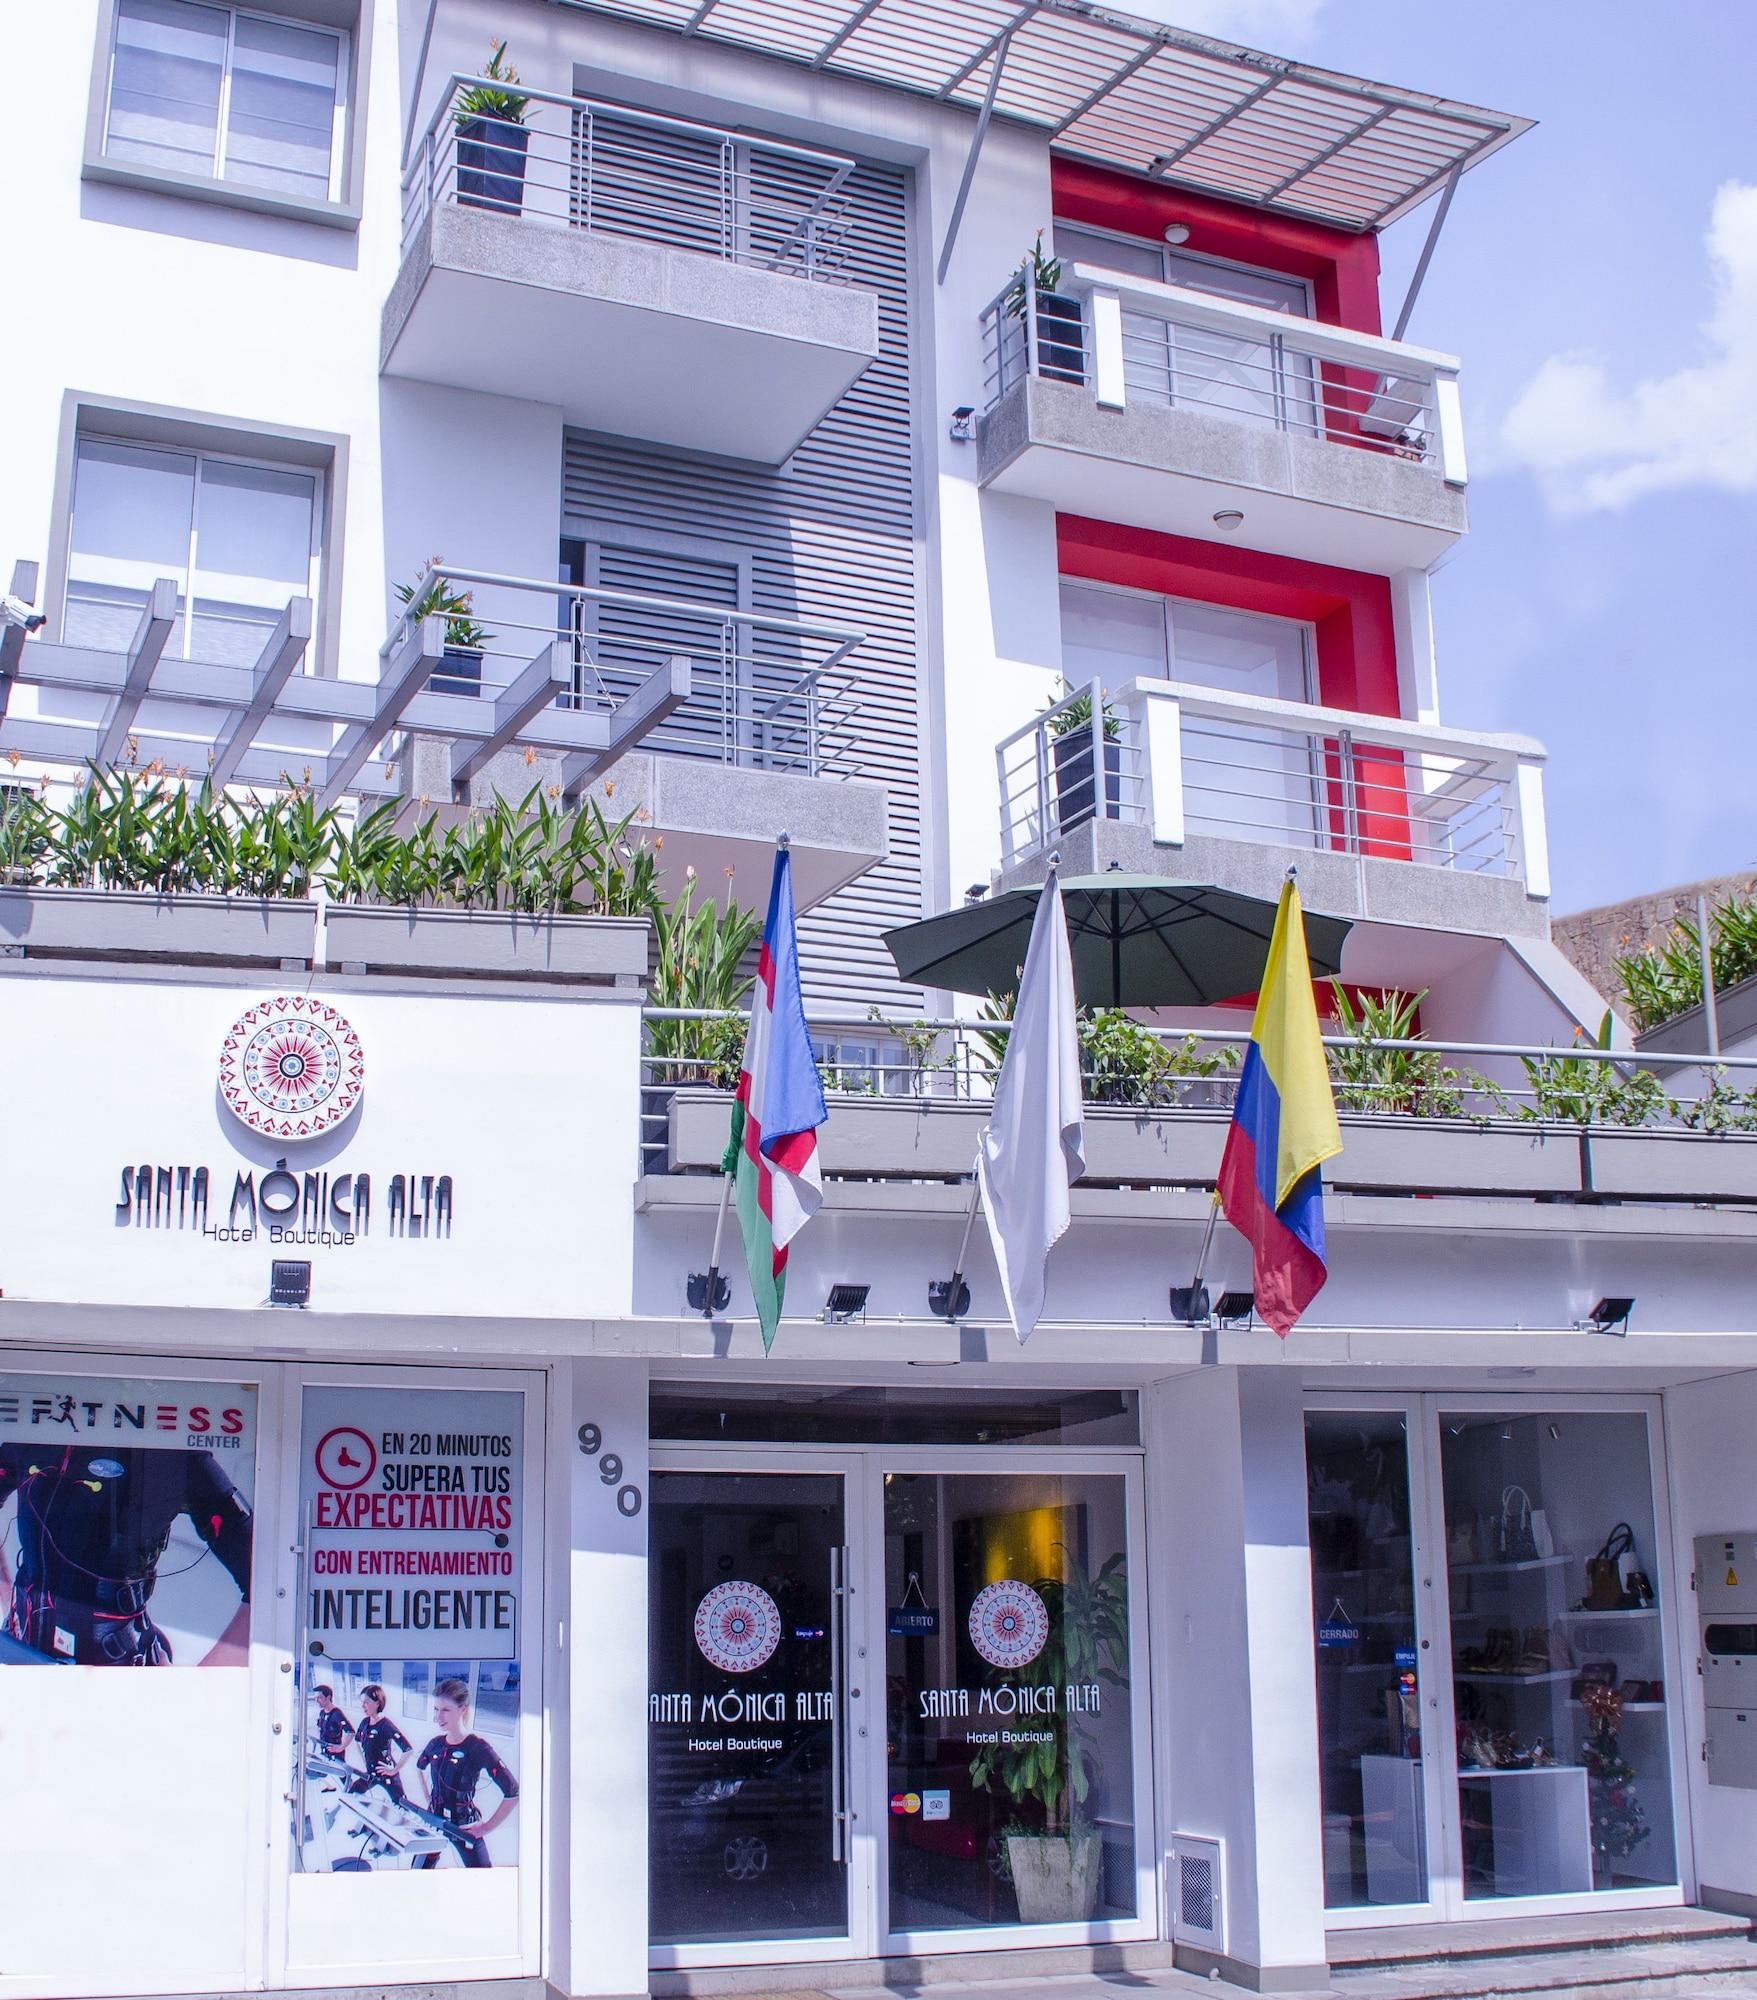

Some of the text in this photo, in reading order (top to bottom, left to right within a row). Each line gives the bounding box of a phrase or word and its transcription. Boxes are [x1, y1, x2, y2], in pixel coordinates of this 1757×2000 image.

[115, 1158, 453, 1220] SANTA MÓNICA ALTA
[203, 1224, 356, 1249] Hotel Boutique
[187, 1434, 241, 1450] CENTER
[382, 1432, 512, 1457] EN 20 MINUTOS
[382, 1464, 510, 1493] SUPERA TUS
[316, 1492, 512, 1530] EXPECTATIVAS
[314, 1550, 513, 1576] CON ENTRENAMIENTO
[312, 1589, 510, 1630] INTELIGENTE
[894, 1615, 934, 1627] ABIERTO
[1319, 1628, 1360, 1640] CERRADO
[649, 1688, 833, 1723] ANTA MÓNICA ALTA
[919, 1683, 1101, 1719] SANTA MÓNICA ALTA
[688, 1737, 783, 1752] Hotel Boutique
[966, 1730, 1054, 1745] Hotel Boutique
